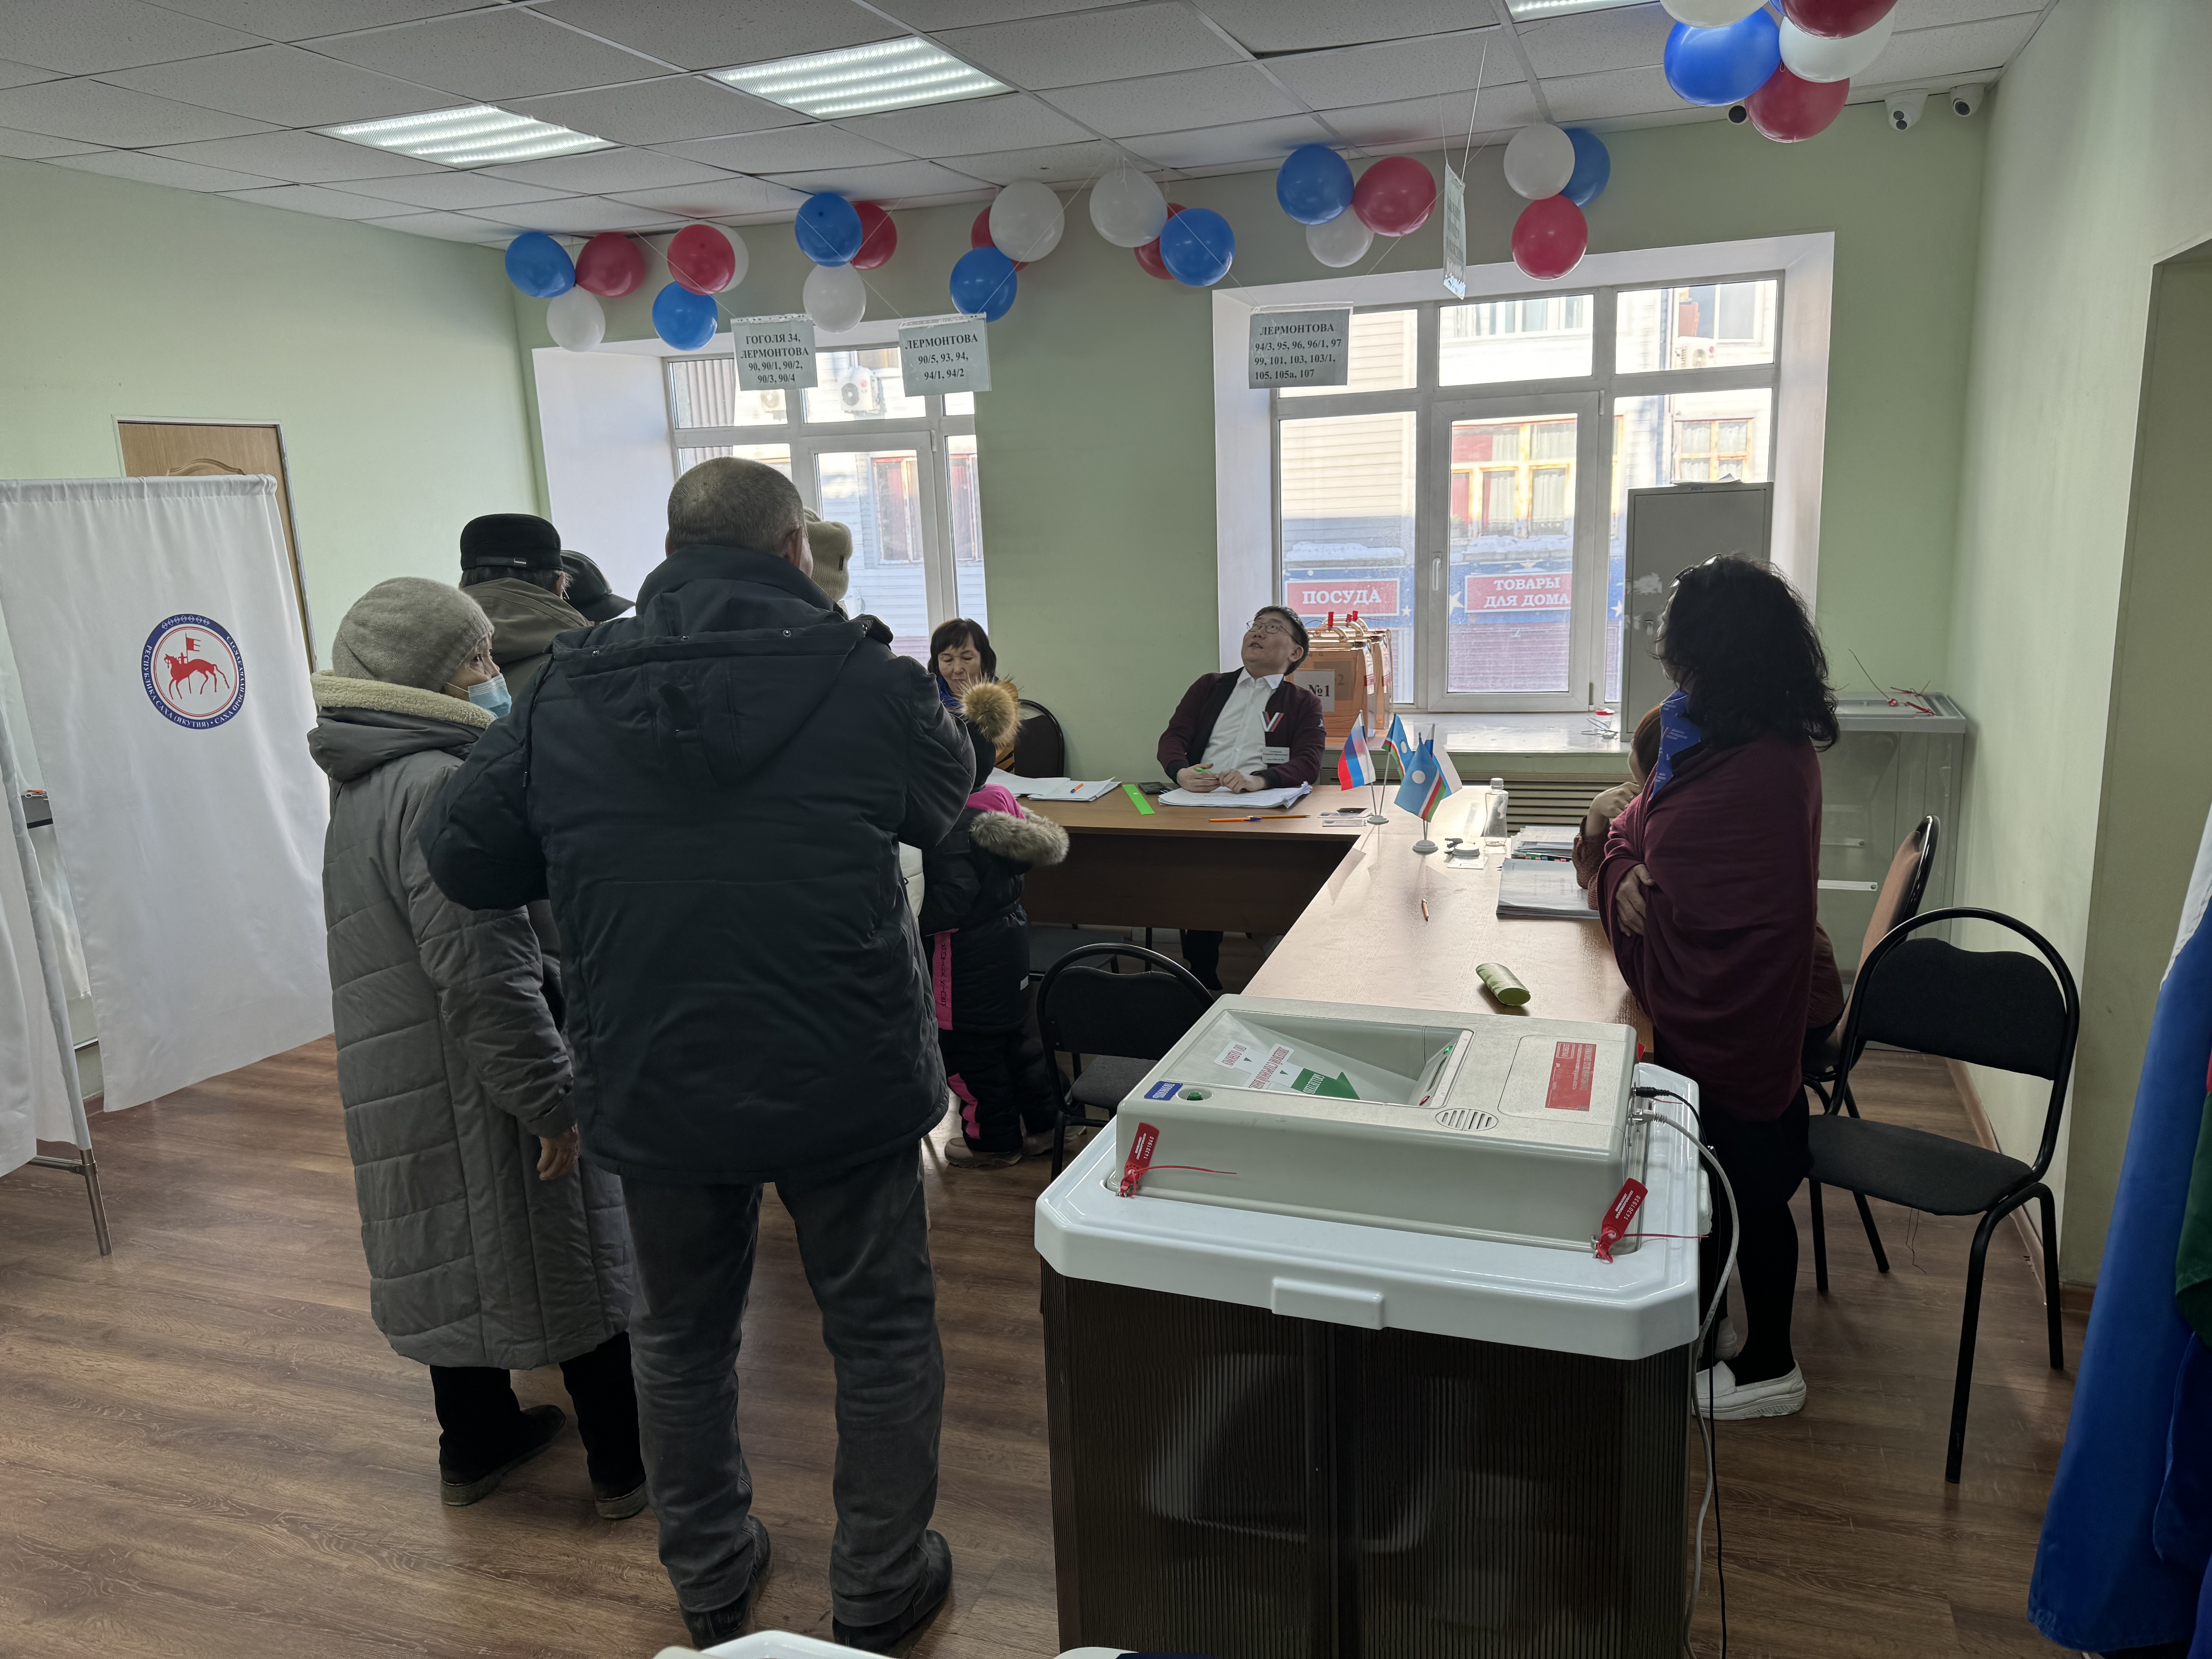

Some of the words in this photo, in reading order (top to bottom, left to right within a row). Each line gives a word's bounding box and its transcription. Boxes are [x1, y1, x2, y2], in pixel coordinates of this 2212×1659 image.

[1260, 323, 1334, 335] ЛЕРМОНТОВА
[746, 334, 785, 344] ГОГОЛЯ
[788, 333, 800, 343] 34,
[905, 333, 978, 349] ЛЕРМОНТОВА
[1255, 342, 1275, 352] 94/3,
[1277, 341, 1290, 350] 95,
[1292, 341, 1305, 349] 96,
[1307, 340, 1328, 349] 96/1,
[1331, 338, 1341, 347] 97
[740, 347, 809, 359] ЛЕРМОНТОВА
[918, 354, 939, 364] 90/5,
[940, 353, 953, 362] 93,
[955, 352, 969, 361] 94,
[749, 362, 760, 371] 90,
[762, 361, 781, 370] 90/1,
[783, 360, 803, 369] 90/2,
[1254, 357, 1267, 366] 99,
[1270, 356, 1287, 365] 101,
[1290, 355, 1307, 364] 103,
[1310, 354, 1336, 363] 103/1,
[757, 374, 777, 383] 90/3,
[778, 373, 795, 383] 90/4
[924, 371, 945, 380] 94/1,
[946, 368, 964, 378] 94/2
[1255, 371, 1272, 380] 105,
[1275, 370, 1297, 379] 105а,
[1300, 369, 1314, 378] 107
[1494, 577, 1560, 591] ТОВАРЫ
[1302, 589, 1381, 605] ПОСУДА
[1484, 595, 1518, 608] ДЛЯ
[1522, 593, 1568, 607] ДОМА
[144, 645, 156, 701] РЕСПУБЛИКА
[156, 701, 172, 718] САХА
[174, 715, 209, 728] (ЯКУТИЯ)
[1308, 684, 1330, 697] №1
[215, 711, 234, 724] САХА
[1235, 1044, 1247, 1054] ПО
[1221, 1050, 1242, 1067] ОДНОМУ
[1269, 1047, 1289, 1065] ЛИЦЕВОЙ
[1256, 1061, 1278, 1083] СТОРОНОЙ
[1249, 1079, 1265, 1089] ВНИ
[1624, 1195, 1640, 1220] 14301938
